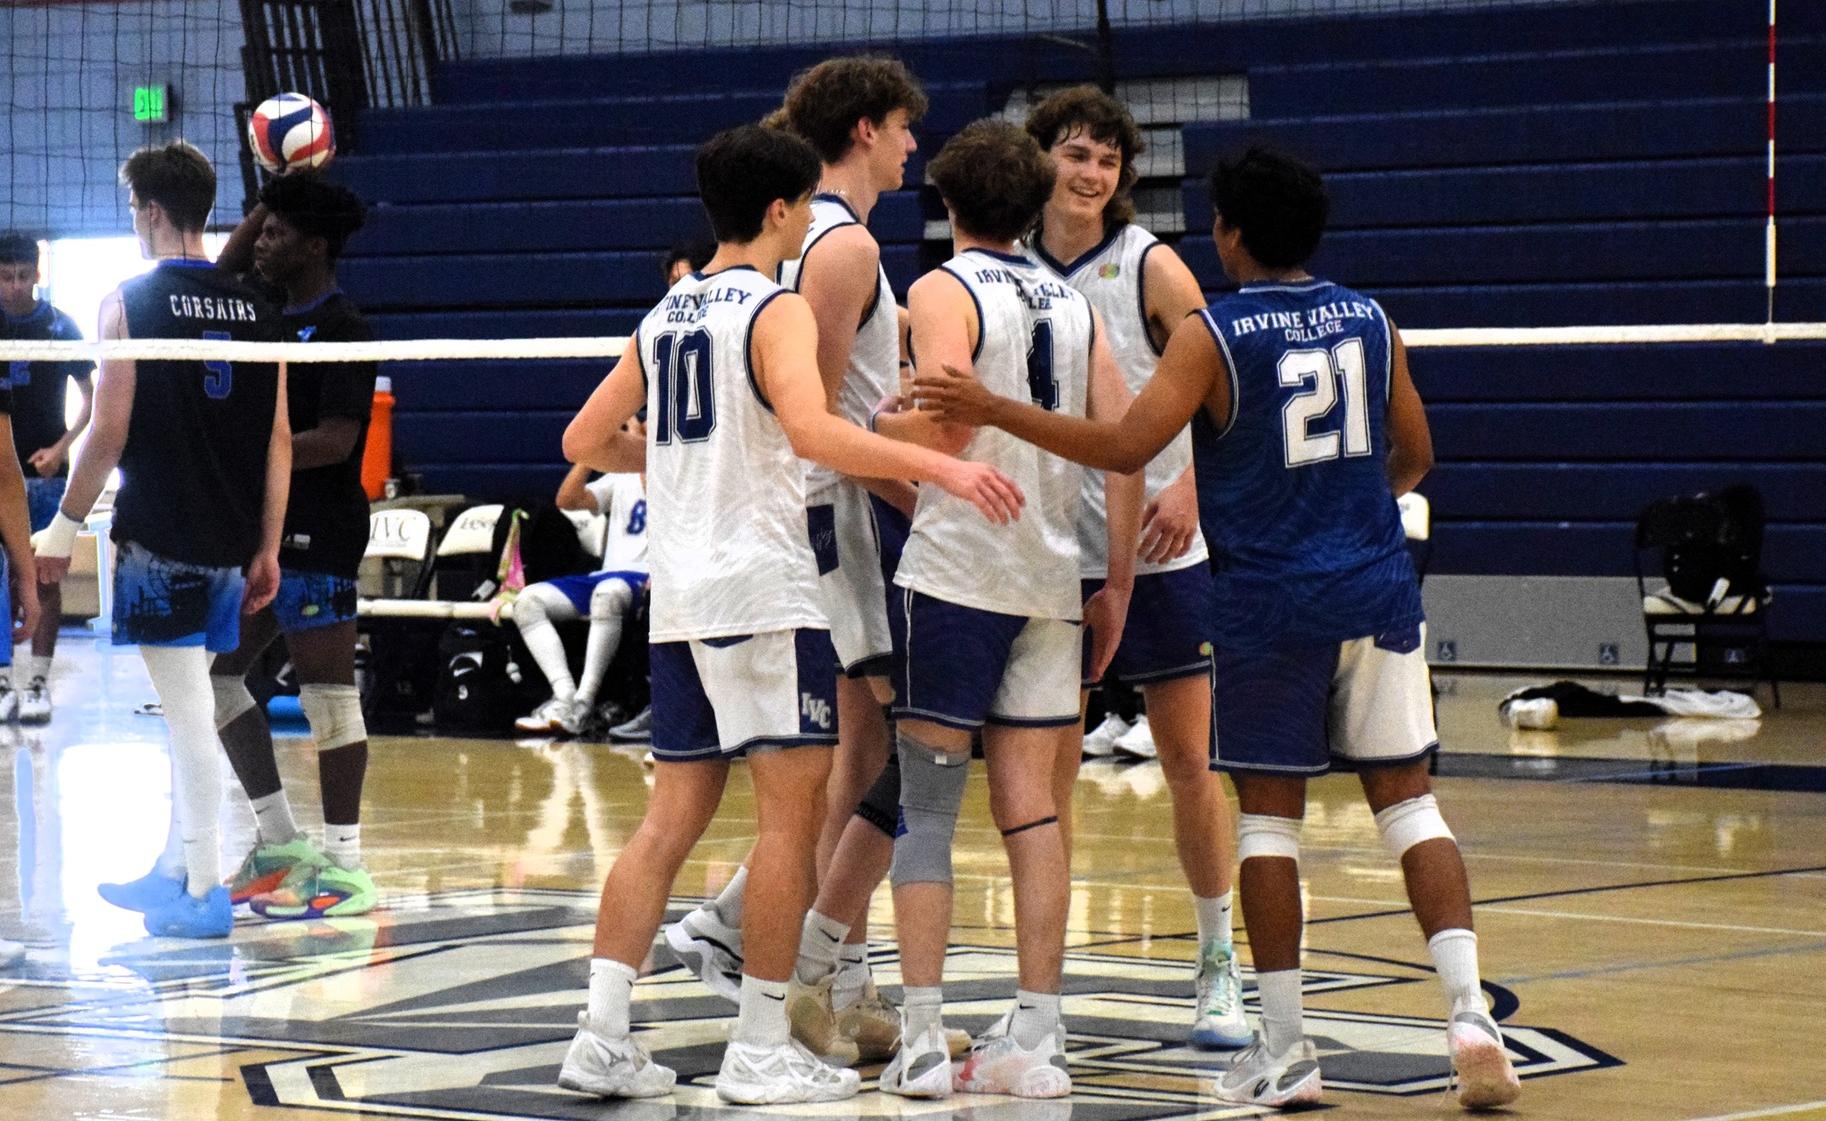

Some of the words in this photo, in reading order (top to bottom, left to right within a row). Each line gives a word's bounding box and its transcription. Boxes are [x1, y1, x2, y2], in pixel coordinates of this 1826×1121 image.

[170, 295, 256, 321] CORSAIRS
[1232, 311, 1303, 336] IRVINE
[1307, 301, 1375, 326] VALLEY
[1285, 320, 1344, 342] COLLEGE
[203, 331, 232, 399] 5
[653, 325, 716, 446] 10
[1277, 336, 1372, 468] 21
[802, 692, 831, 729] IVC
